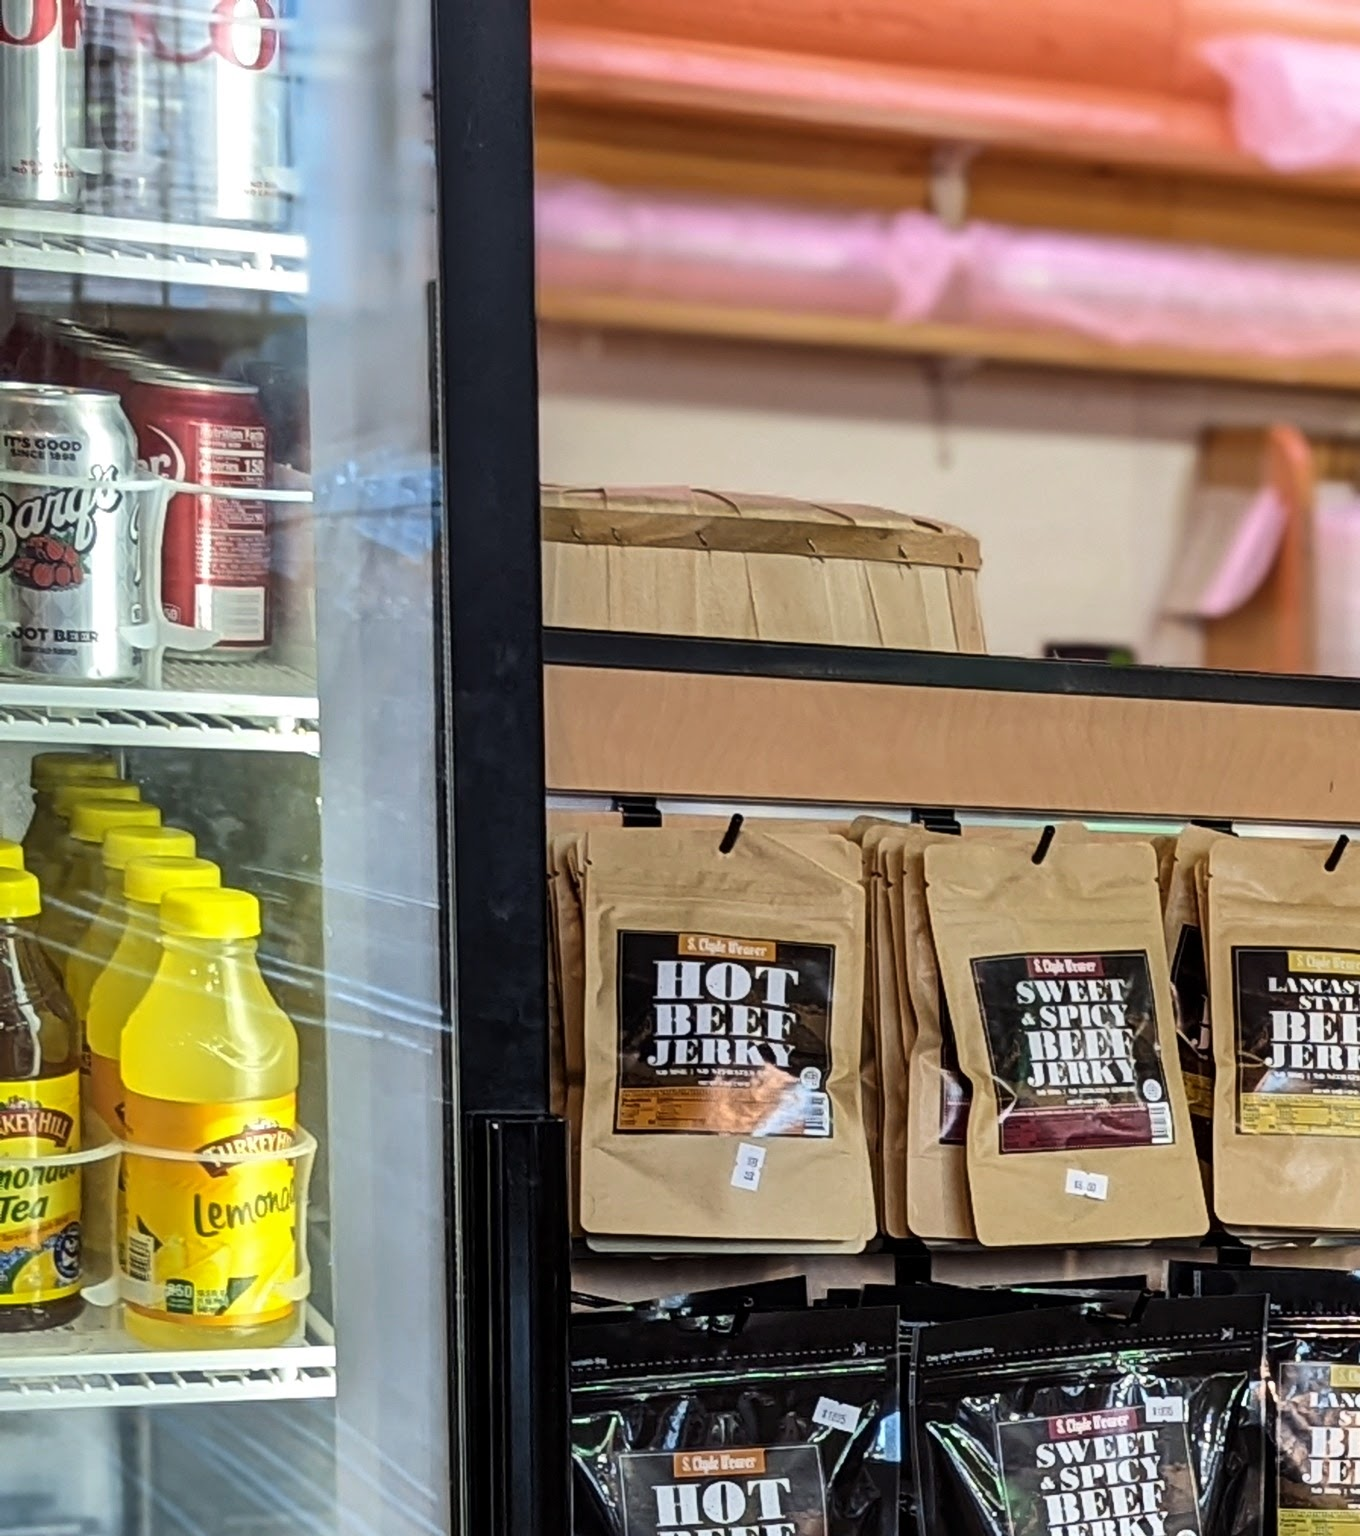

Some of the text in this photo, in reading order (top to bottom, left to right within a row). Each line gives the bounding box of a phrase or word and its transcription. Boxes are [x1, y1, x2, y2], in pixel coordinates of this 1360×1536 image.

[4, 435, 82, 452] IT'S GOOD
[244, 458, 265, 474] 150
[54, 629, 98, 643] BEER
[653, 960, 799, 1008] HOT
[1015, 978, 1126, 1004] SWEET
[654, 1003, 797, 1041] BEEF
[1021, 1004, 1128, 1029] & SPICY
[647, 1038, 796, 1068] JERKY
[1025, 1028, 1134, 1061] BEEF
[1027, 1059, 1136, 1088] JERKY
[40, 1111, 69, 1141] HILL
[0, 1196, 49, 1225] Tea
[1035, 1430, 1160, 1470] SWEET
[1040, 1455, 1161, 1493] & SPICY
[652, 1477, 791, 1527] HOT
[1043, 1479, 1167, 1527] BEEF
